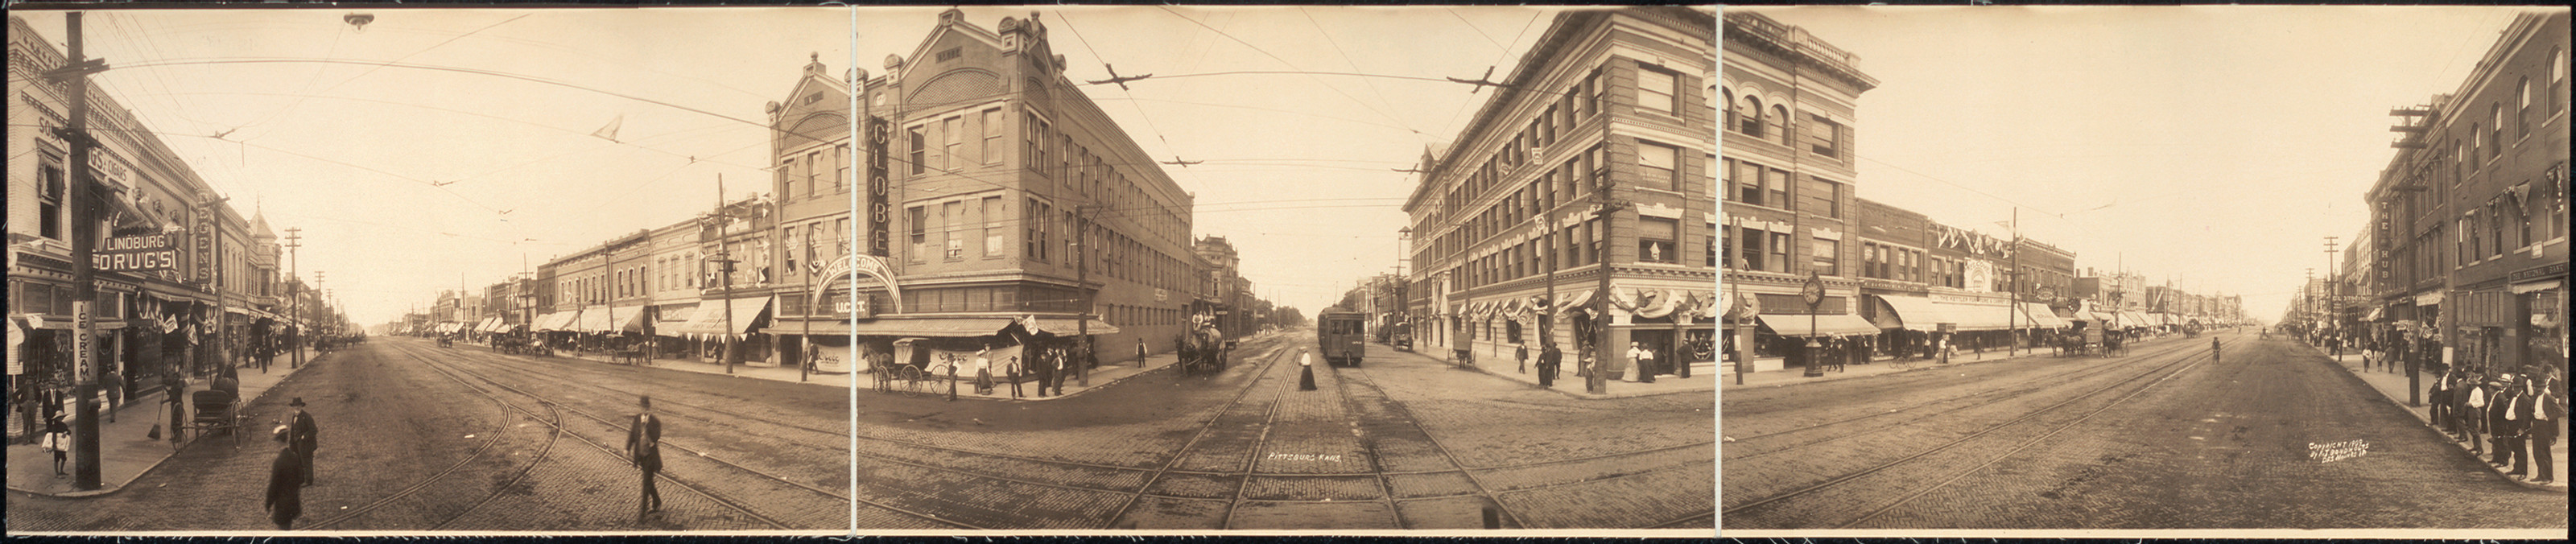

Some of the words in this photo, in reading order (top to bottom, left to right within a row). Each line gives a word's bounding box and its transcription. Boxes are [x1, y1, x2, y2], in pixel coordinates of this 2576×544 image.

[108, 159, 127, 182] CIGARS
[874, 124, 886, 250] GLOBE
[2381, 201, 2389, 230] THE
[99, 251, 171, 270] DRUGS
[828, 258, 879, 276] WELCOME
[2381, 250, 2389, 279] HUB
[78, 304, 87, 330] ICE
[79, 332, 89, 378] CREAM
